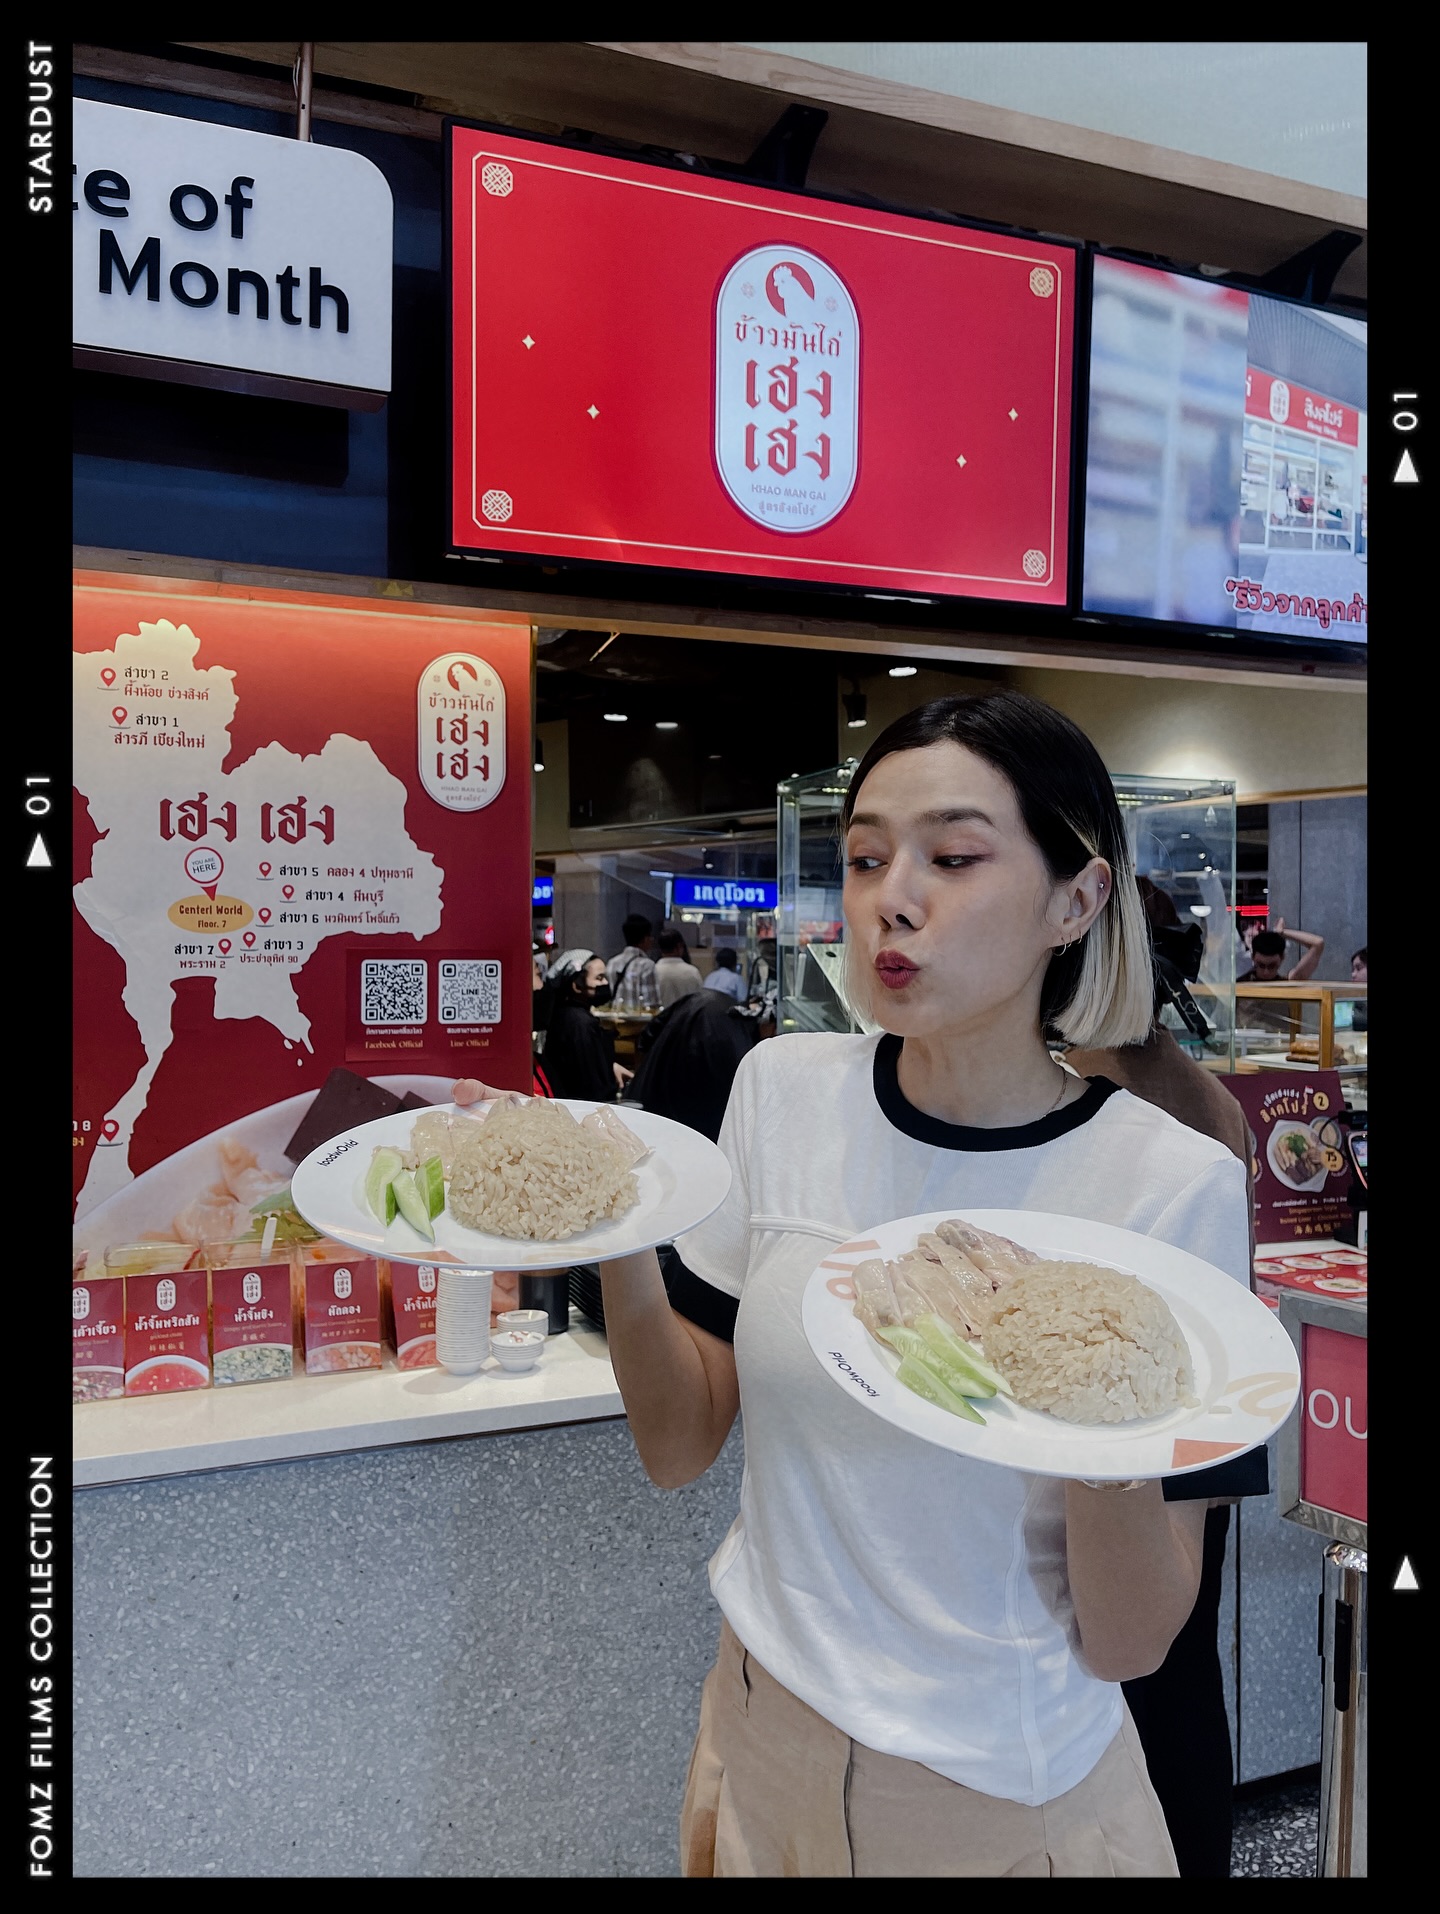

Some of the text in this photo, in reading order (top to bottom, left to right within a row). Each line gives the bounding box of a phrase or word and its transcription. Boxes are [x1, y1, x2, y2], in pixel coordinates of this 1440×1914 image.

[169, 176, 254, 238] of
[99, 228, 349, 333] Month
[735, 314, 842, 357] ข้าวมันไก่
[745, 356, 831, 419] เฮง
[745, 418, 830, 481] เฮง
[751, 484, 826, 500] KHAO MAN GAI
[124, 666, 169, 681] สาขา 2
[429, 692, 494, 712] ข้าวมันไก่
[135, 713, 179, 728] สาขา 1
[436, 713, 490, 747] เฮง
[114, 731, 148, 746] สารภี
[436, 748, 490, 782] เฮง
[159, 791, 336, 846] เฮง เฮง
[192, 862, 217, 874] HERE
[279, 864, 307, 877] สาขา
[311, 867, 319, 877] 5
[359, 868, 365, 878] 4
[305, 889, 333, 901] สาขา
[337, 892, 344, 901] 4
[215, 905, 243, 916] World
[279, 911, 307, 924] สาขา
[311, 913, 319, 924] 6
[221, 920, 227, 928] 7
[174, 943, 214, 956] สาขา 7
[264, 939, 304, 951] สาขา 3
[219, 960, 226, 969] 2
[461, 988, 480, 996] LINE
[365, 1040, 424, 1049] Facebook Official
[466, 1039, 490, 1047] Official
[1317, 1095, 1325, 1107] 2
[82, 1120, 92, 1132] 8
